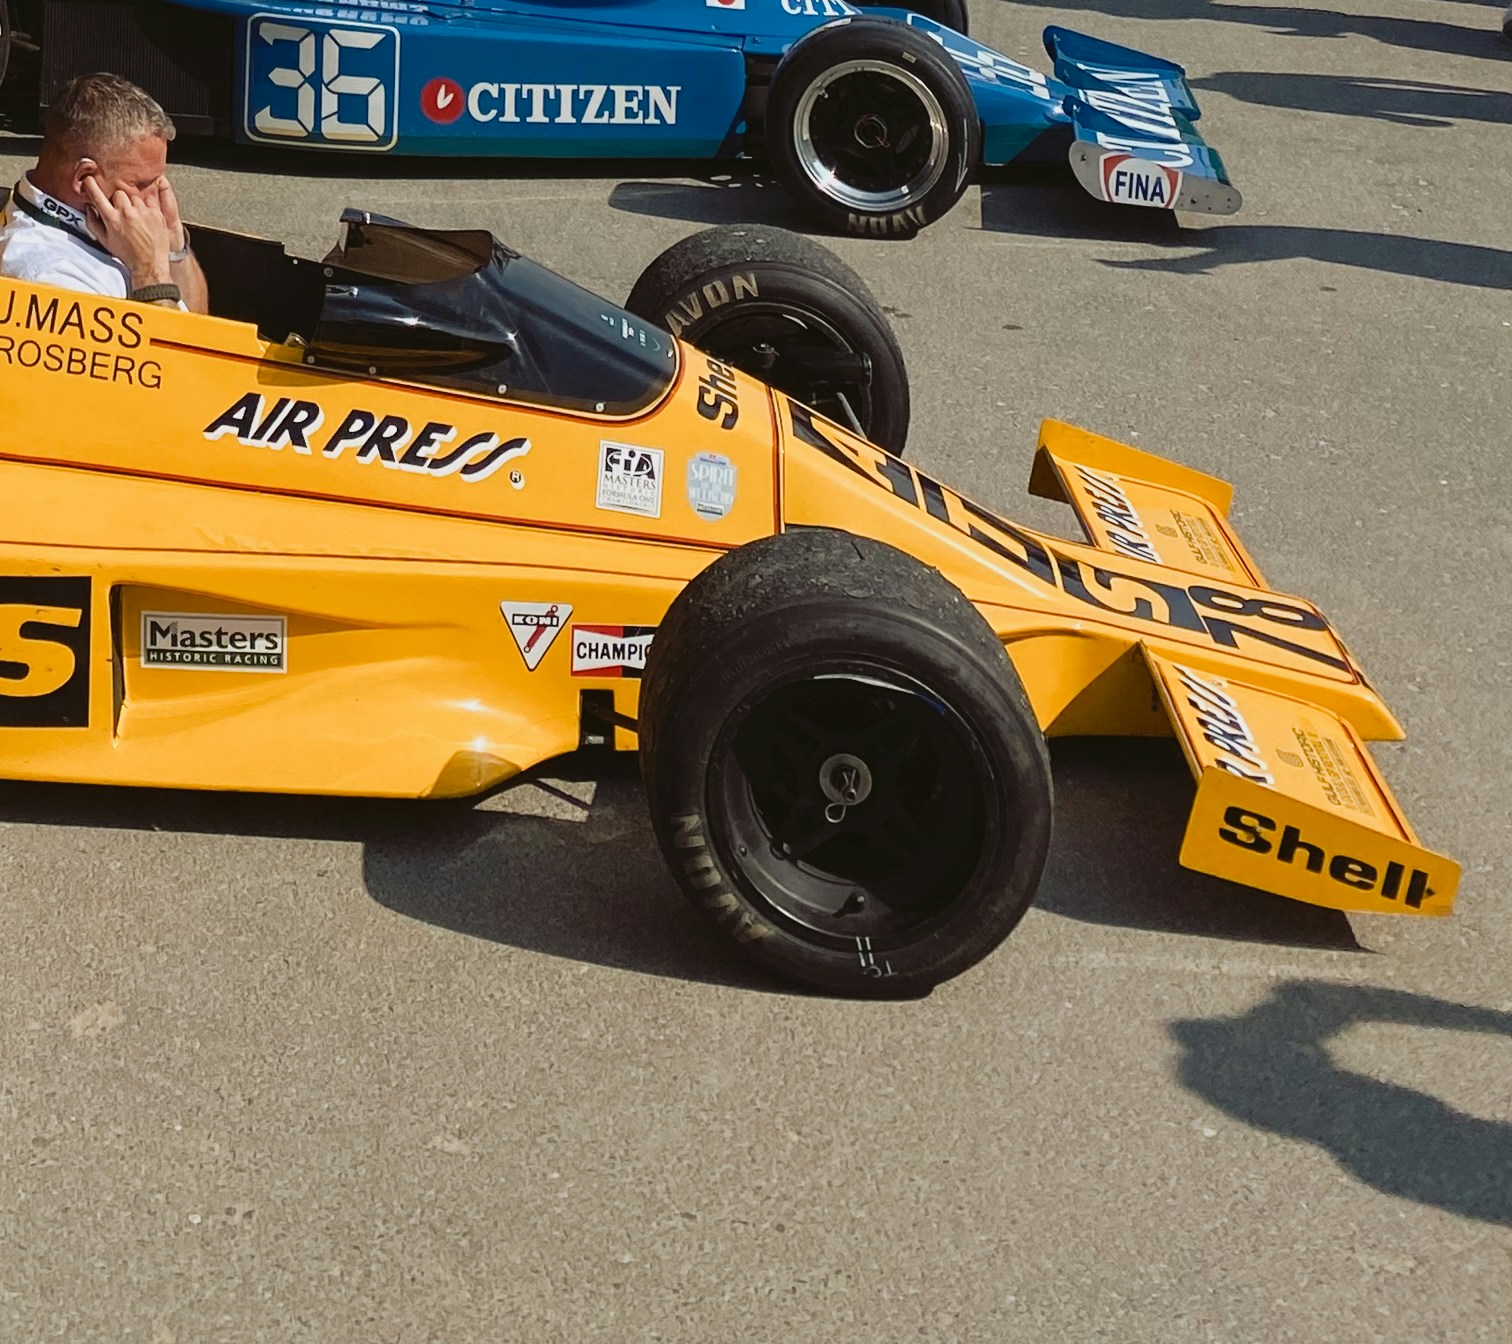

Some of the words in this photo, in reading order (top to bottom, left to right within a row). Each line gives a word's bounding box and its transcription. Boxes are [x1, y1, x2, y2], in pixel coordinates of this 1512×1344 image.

[253, 21, 388, 143] 36
[467, 82, 682, 126] CITIZEN
[1113, 169, 1166, 205] FINA
[43, 197, 84, 230] GPX
[664, 273, 761, 338] AVON
[696, 357, 740, 431] She
[203, 392, 324, 454] AIR
[323, 409, 531, 483] PRESS
[603, 473, 656, 491] MASTERS
[690, 463, 736, 486] SPIRIT
[602, 489, 638, 502] FORMULA
[149, 620, 279, 651] Masters
[513, 614, 559, 627] KONI
[149, 651, 218, 663] HISTORIC
[224, 653, 279, 666] RACING
[1217, 803, 1437, 910] Shell
